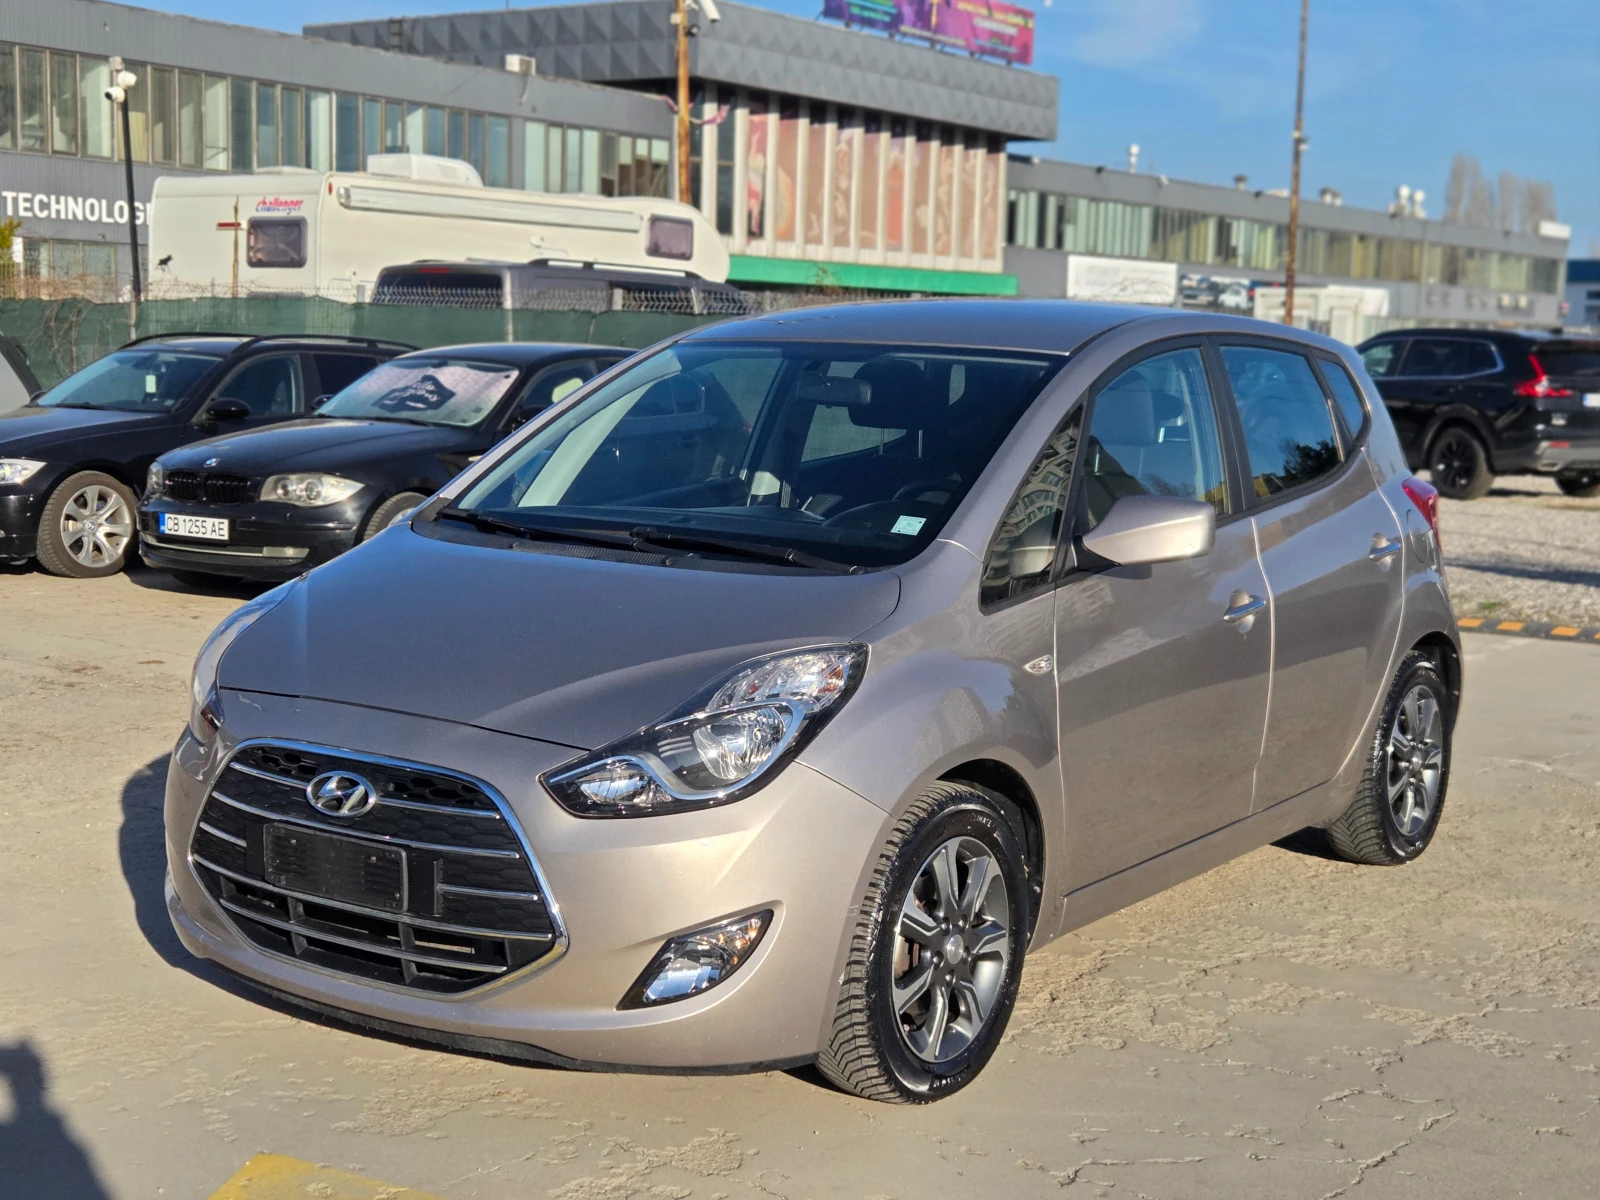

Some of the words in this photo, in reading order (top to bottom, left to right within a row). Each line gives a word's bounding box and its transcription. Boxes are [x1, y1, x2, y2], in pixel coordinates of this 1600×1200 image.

[166, 516, 180, 532] CB
[183, 518, 208, 535] 1255
[210, 521, 225, 537] AE
